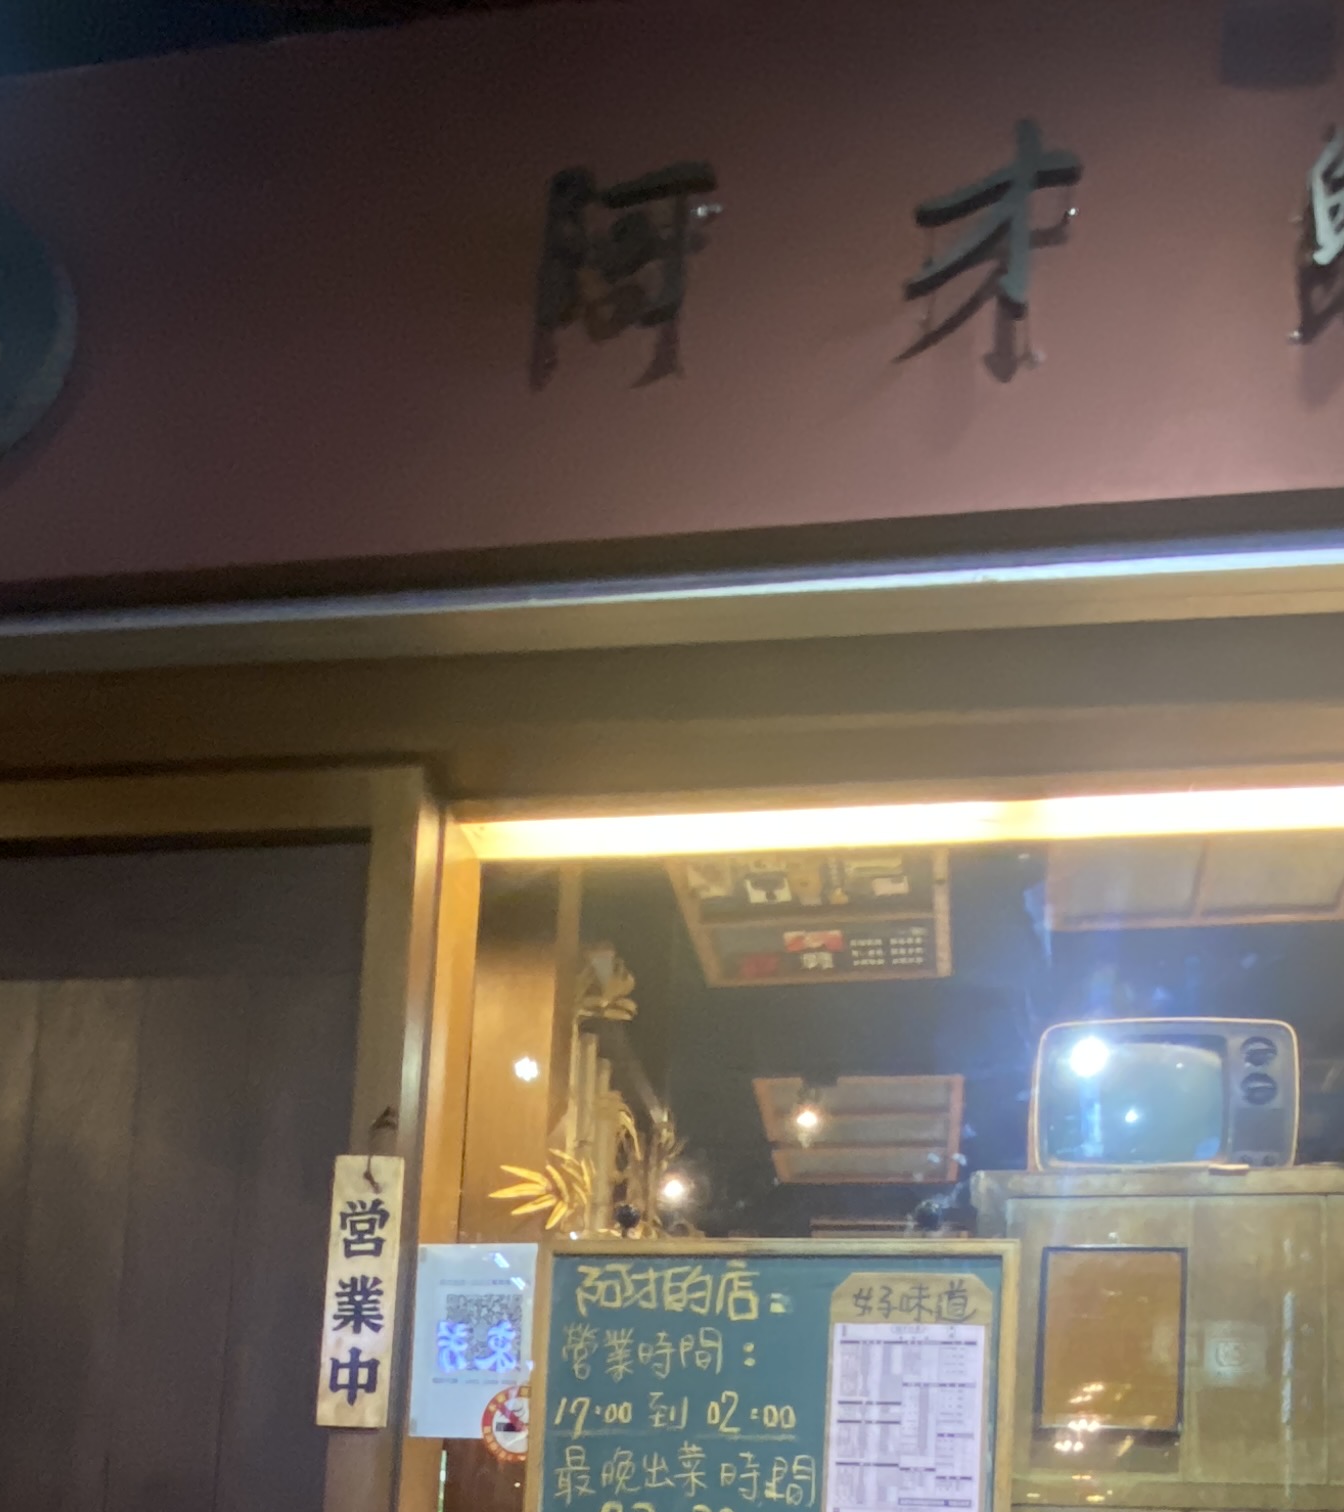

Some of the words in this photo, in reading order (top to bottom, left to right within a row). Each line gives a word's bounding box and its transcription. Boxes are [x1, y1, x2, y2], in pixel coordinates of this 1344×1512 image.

[852, 1278, 977, 1324] 好味道
[554, 1396, 633, 1440] 17:00
[648, 1391, 689, 1431] 到
[706, 1390, 797, 1434] 02:00
[553, 1440, 817, 1508] 最晚出菜時間
